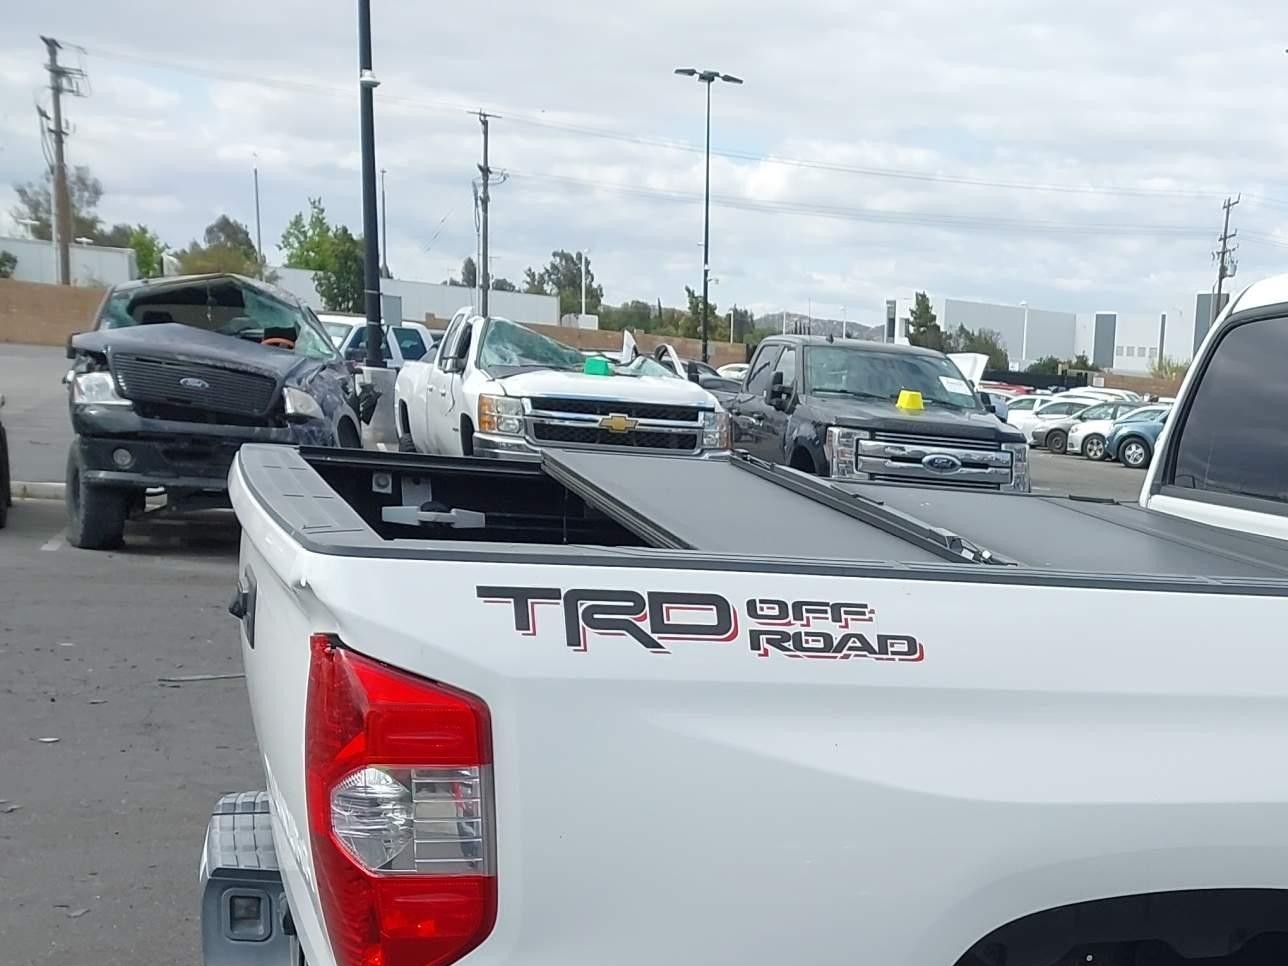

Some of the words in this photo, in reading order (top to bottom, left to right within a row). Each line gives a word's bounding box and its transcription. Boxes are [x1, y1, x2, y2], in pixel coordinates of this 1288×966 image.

[476, 585, 738, 654] TRD
[746, 598, 876, 628] OFF
[748, 629, 925, 662] ROAD
